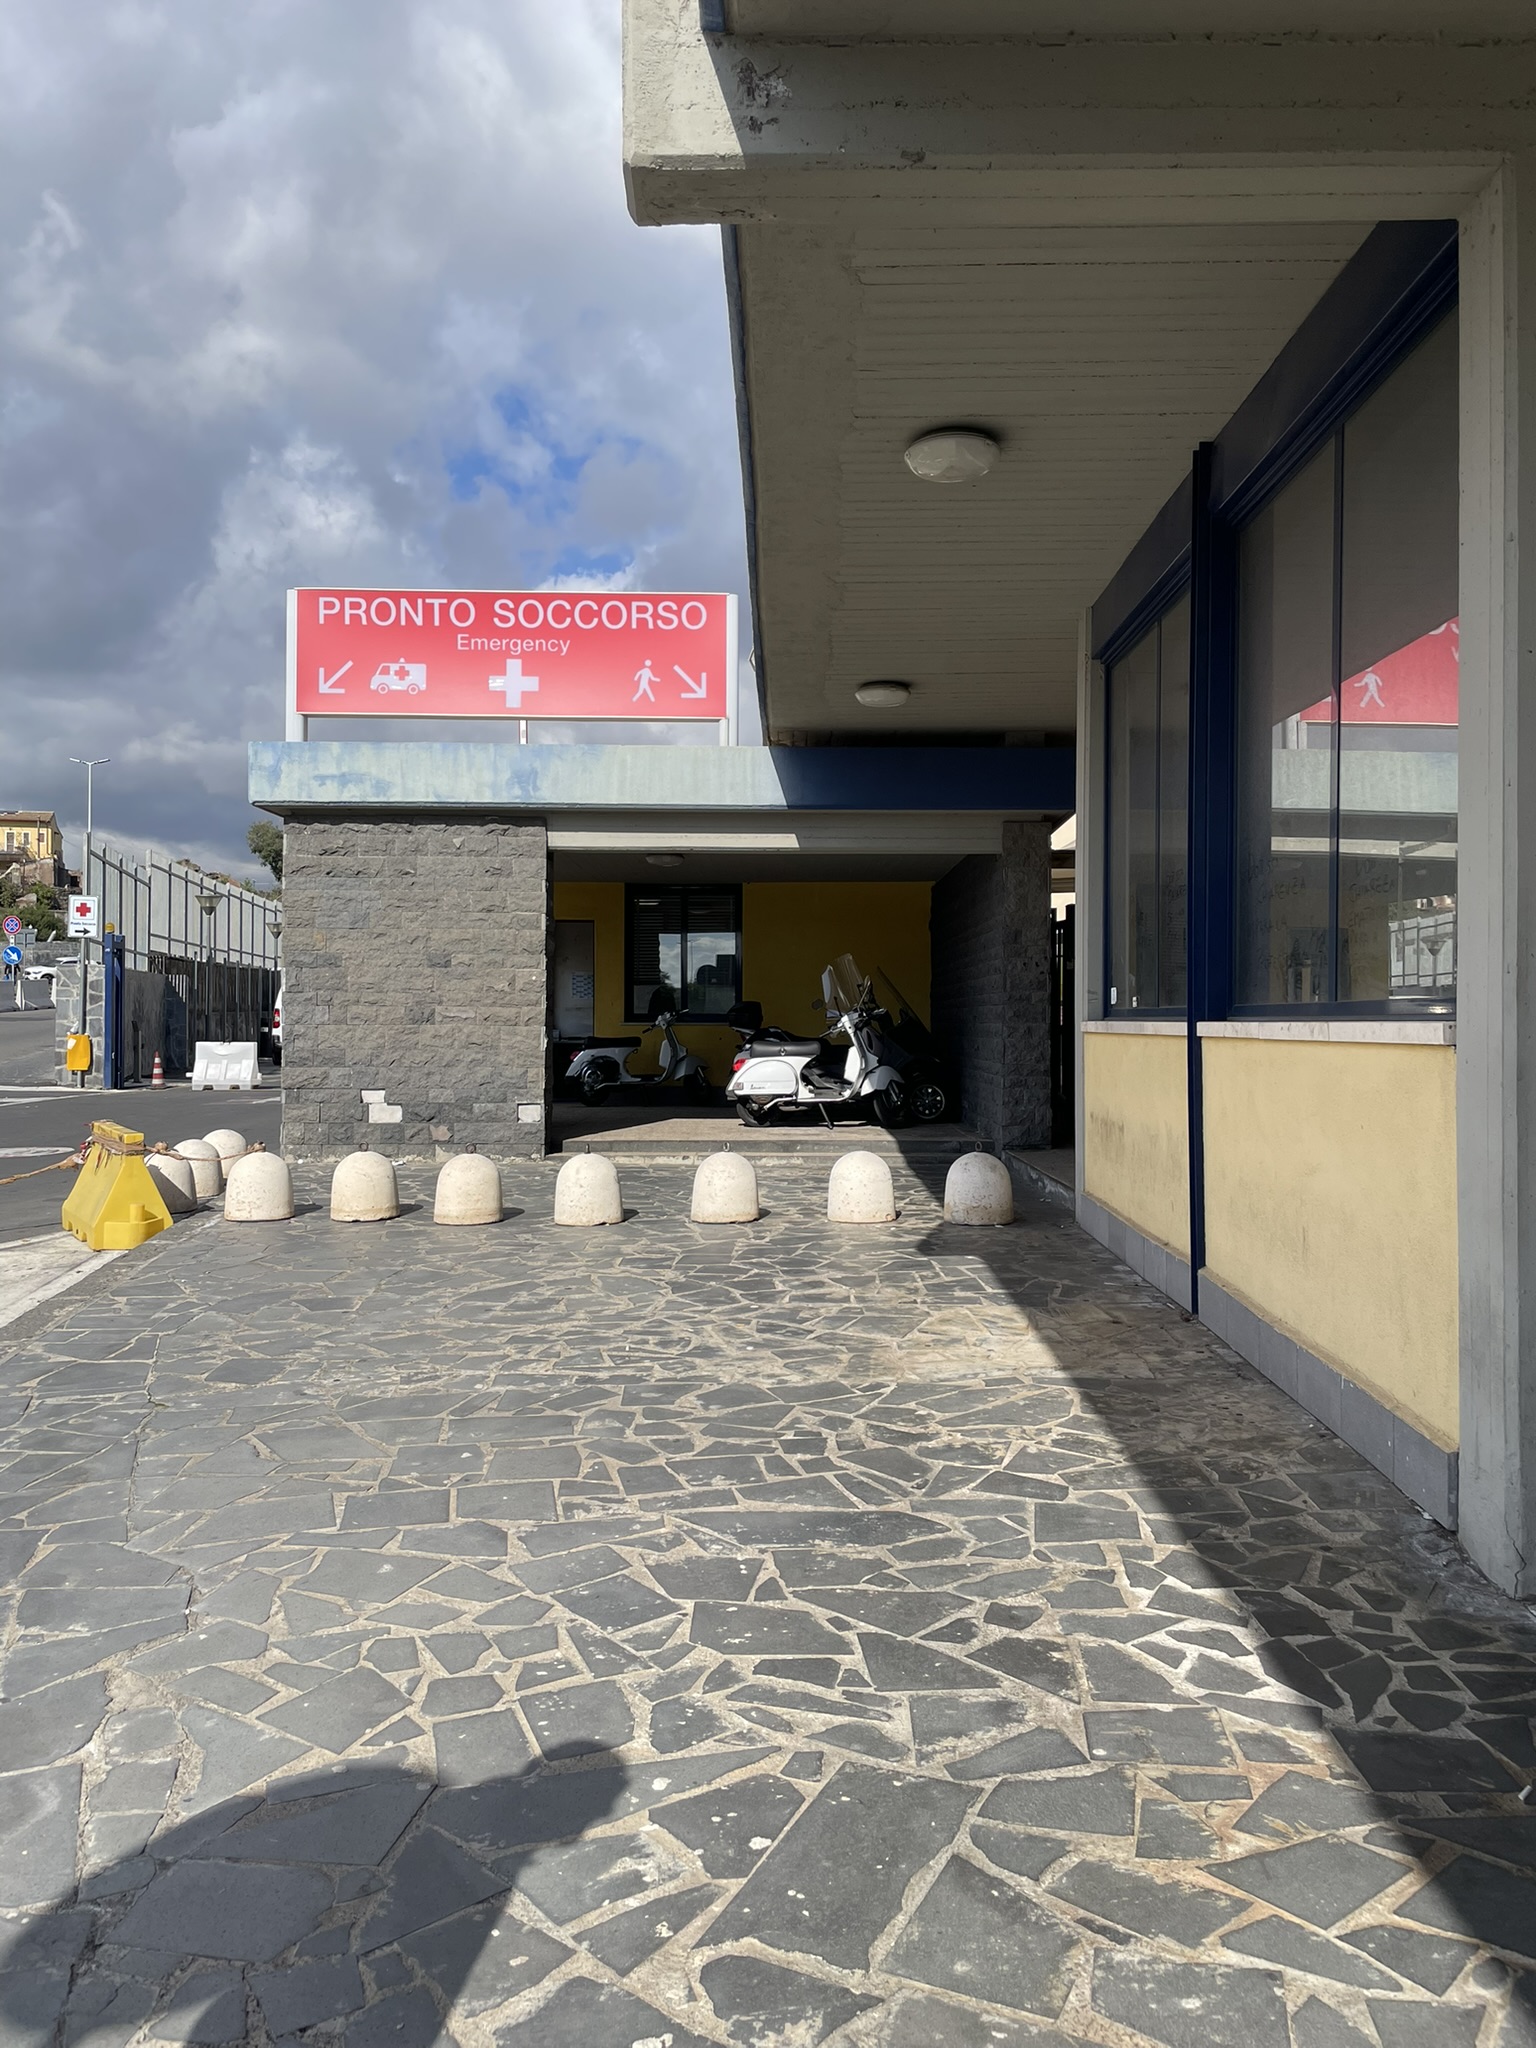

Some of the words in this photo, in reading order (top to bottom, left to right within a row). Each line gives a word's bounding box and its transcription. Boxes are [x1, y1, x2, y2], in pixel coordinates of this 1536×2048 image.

[318, 596, 476, 628] PRONTO
[493, 599, 707, 630] SOCCORSO
[456, 633, 571, 656] Emergency
